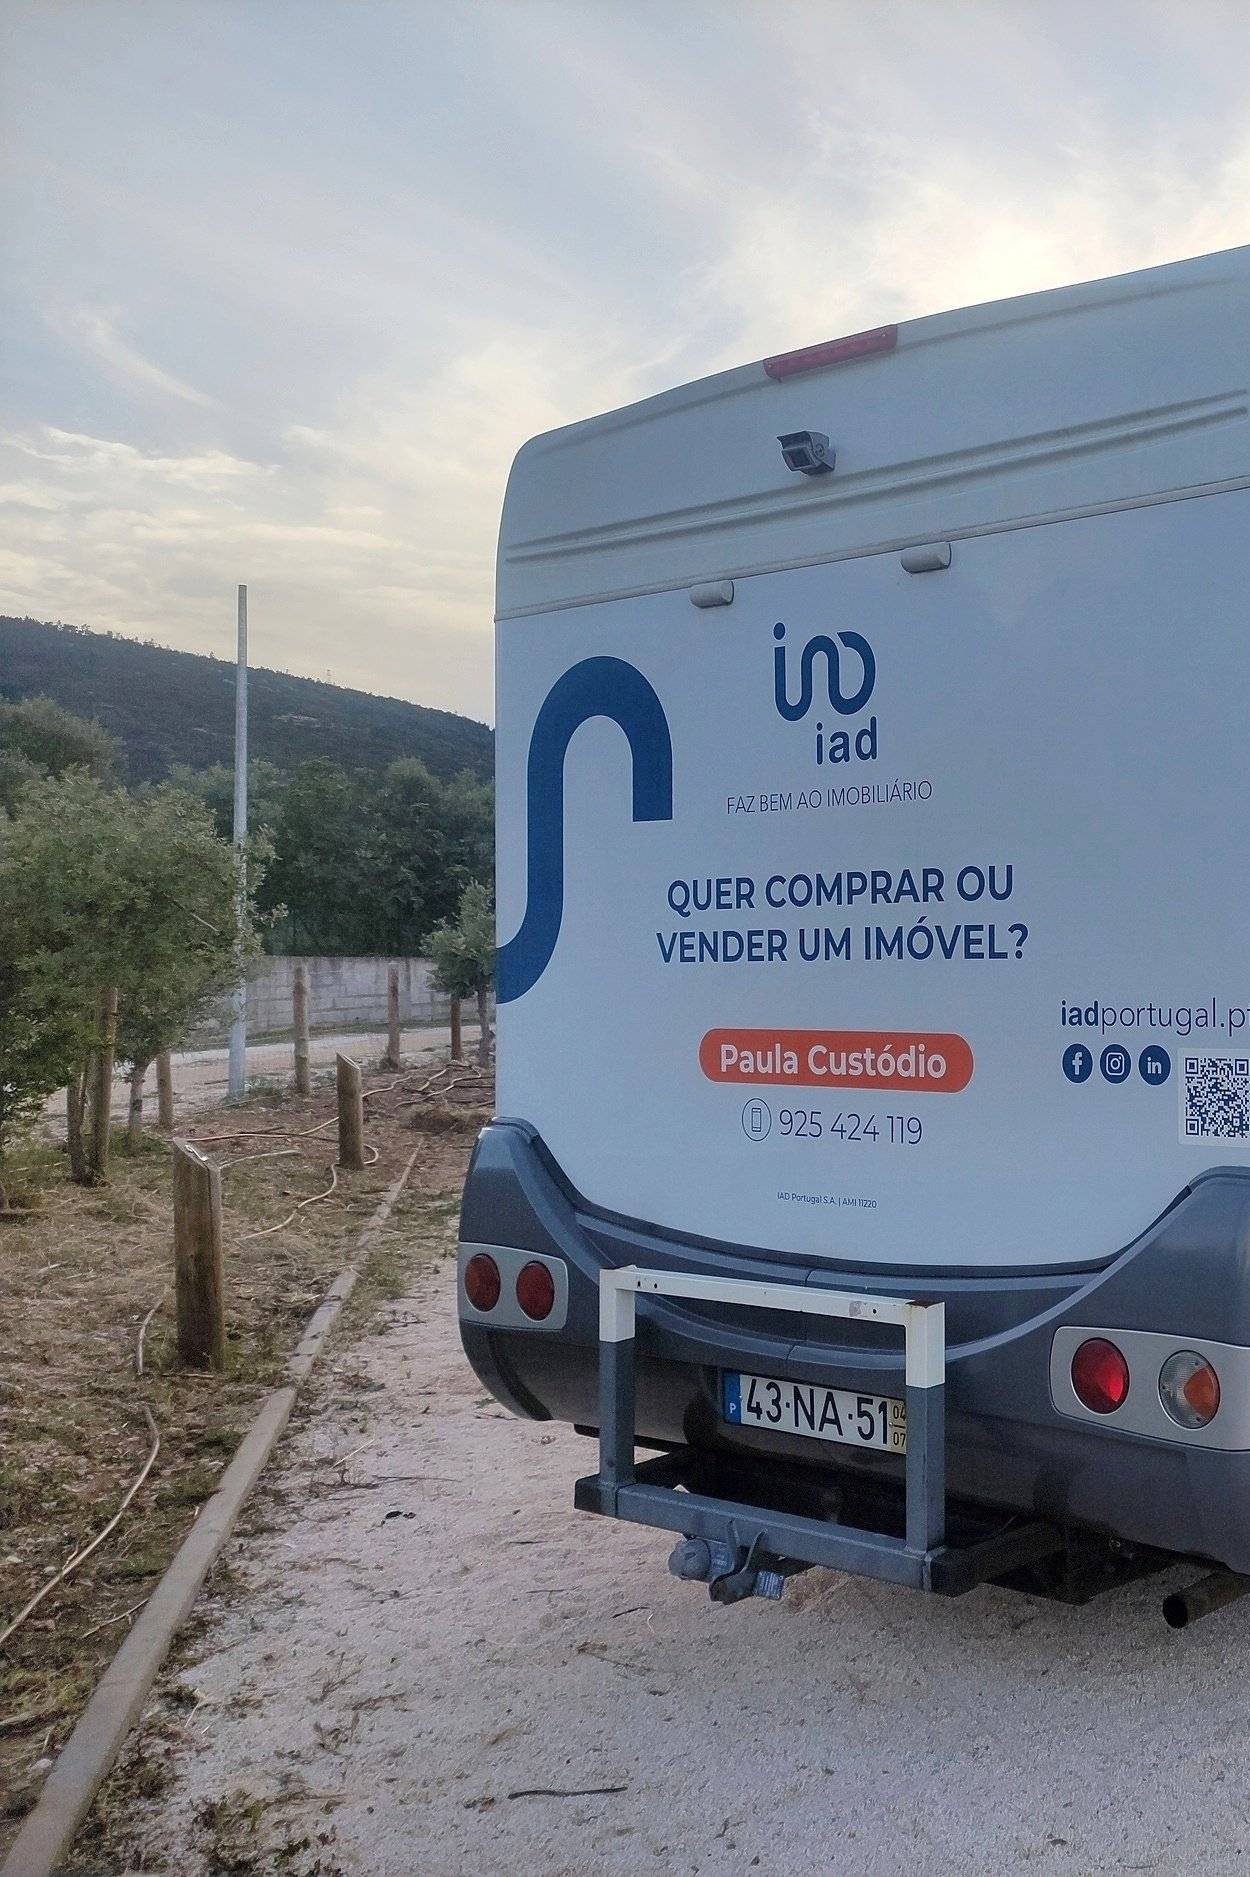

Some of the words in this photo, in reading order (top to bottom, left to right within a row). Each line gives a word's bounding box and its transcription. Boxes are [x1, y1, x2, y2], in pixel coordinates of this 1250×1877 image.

[816, 716, 878, 766] iad
[727, 796, 757, 815] FAZ
[759, 793, 794, 813] BEM
[796, 789, 823, 811] AO
[826, 778, 934, 809] IMOBILIÁRIO
[667, 877, 756, 918] QUER
[765, 868, 946, 910] COMPRAR
[956, 864, 1015, 902] OU
[656, 929, 788, 964] VENDER
[798, 927, 853, 963] UM
[863, 916, 1031, 962] IMÓVEL?
[720, 1043, 800, 1076] Paula
[807, 1043, 948, 1080] Custódio
[779, 1109, 824, 1139] 925
[830, 1112, 881, 1143] 424
[886, 1114, 924, 1147] 119
[777, 1191, 791, 1201] IAD
[791, 1193, 822, 1205] Portugal
[842, 1197, 857, 1207] AMI
[857, 1198, 878, 1209] 11220
[729, 1402, 737, 1415] P
[893, 1405, 907, 1420] 04
[893, 1431, 907, 1446] 07
